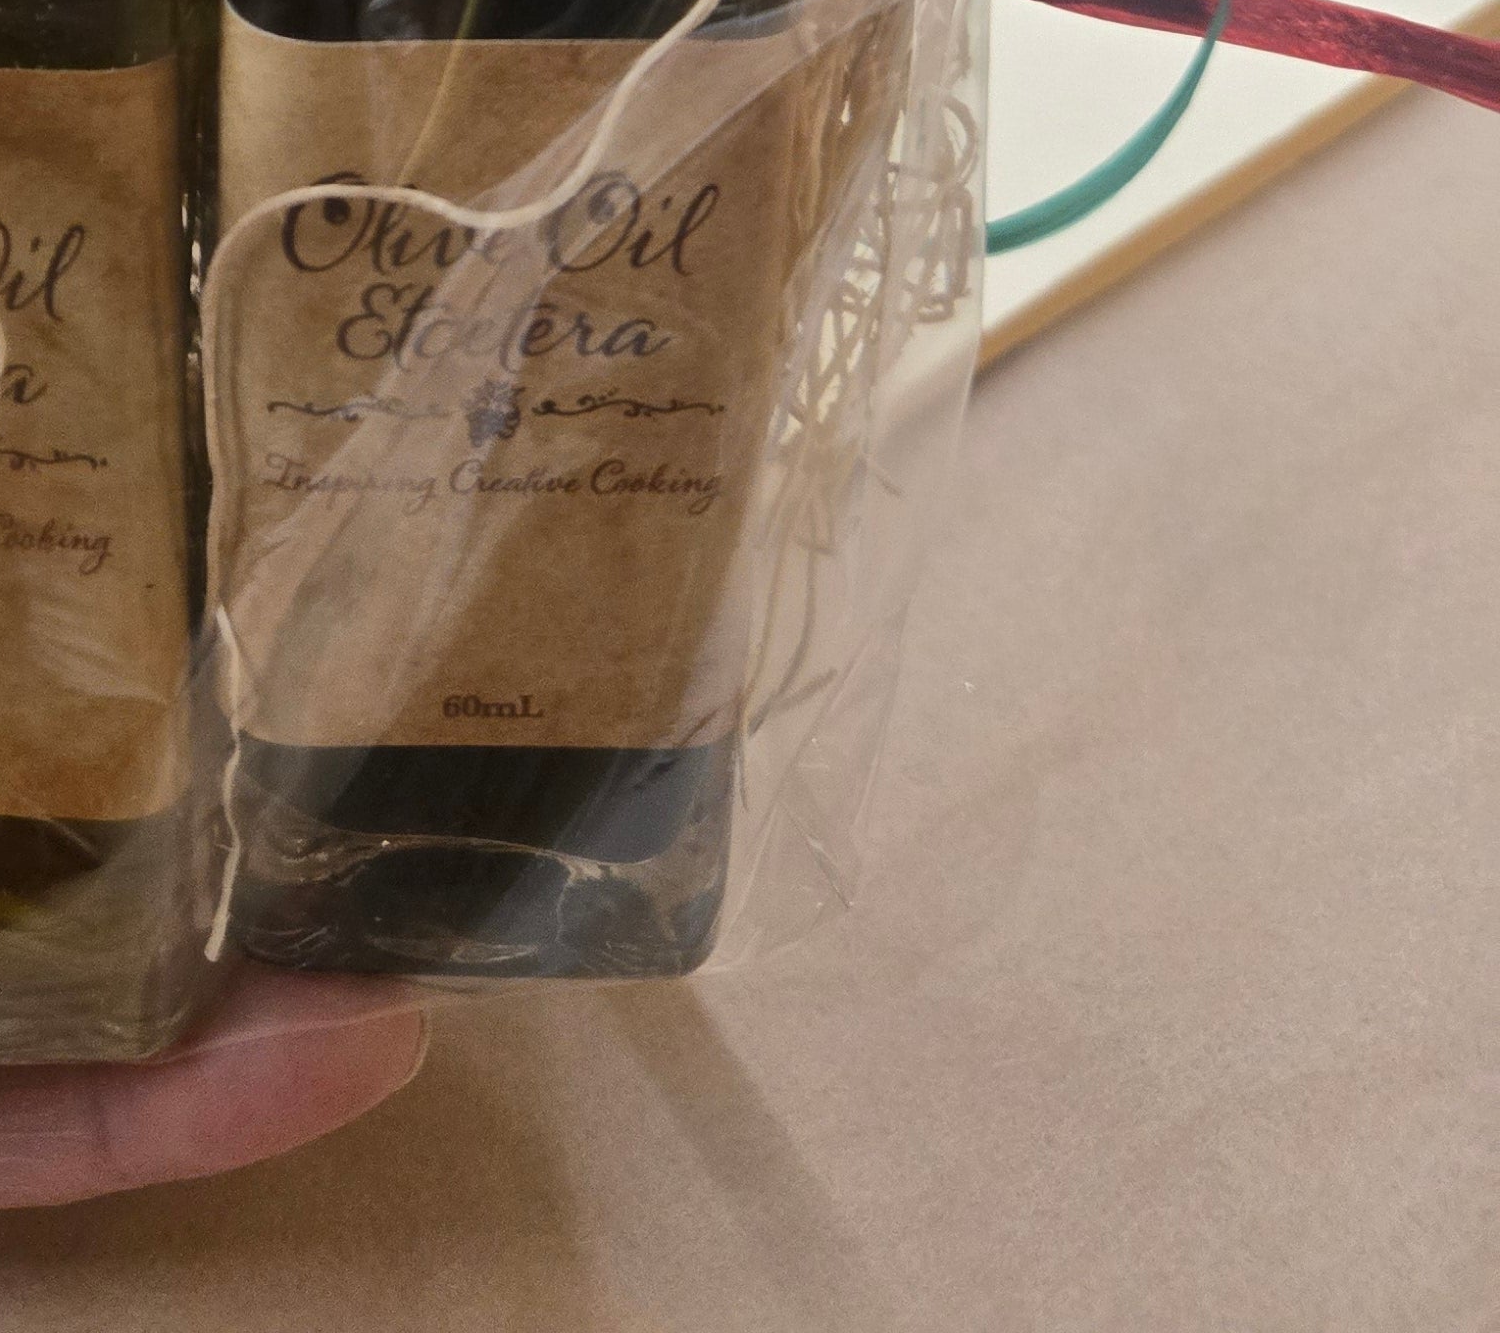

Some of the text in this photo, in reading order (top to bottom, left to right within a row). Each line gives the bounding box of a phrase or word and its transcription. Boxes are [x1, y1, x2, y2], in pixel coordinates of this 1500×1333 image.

[281, 170, 720, 277] Olive Oil
[336, 282, 673, 373] Etcetera
[449, 458, 581, 497] Creative
[589, 458, 722, 516] Cooking
[443, 693, 546, 719] 60mL
